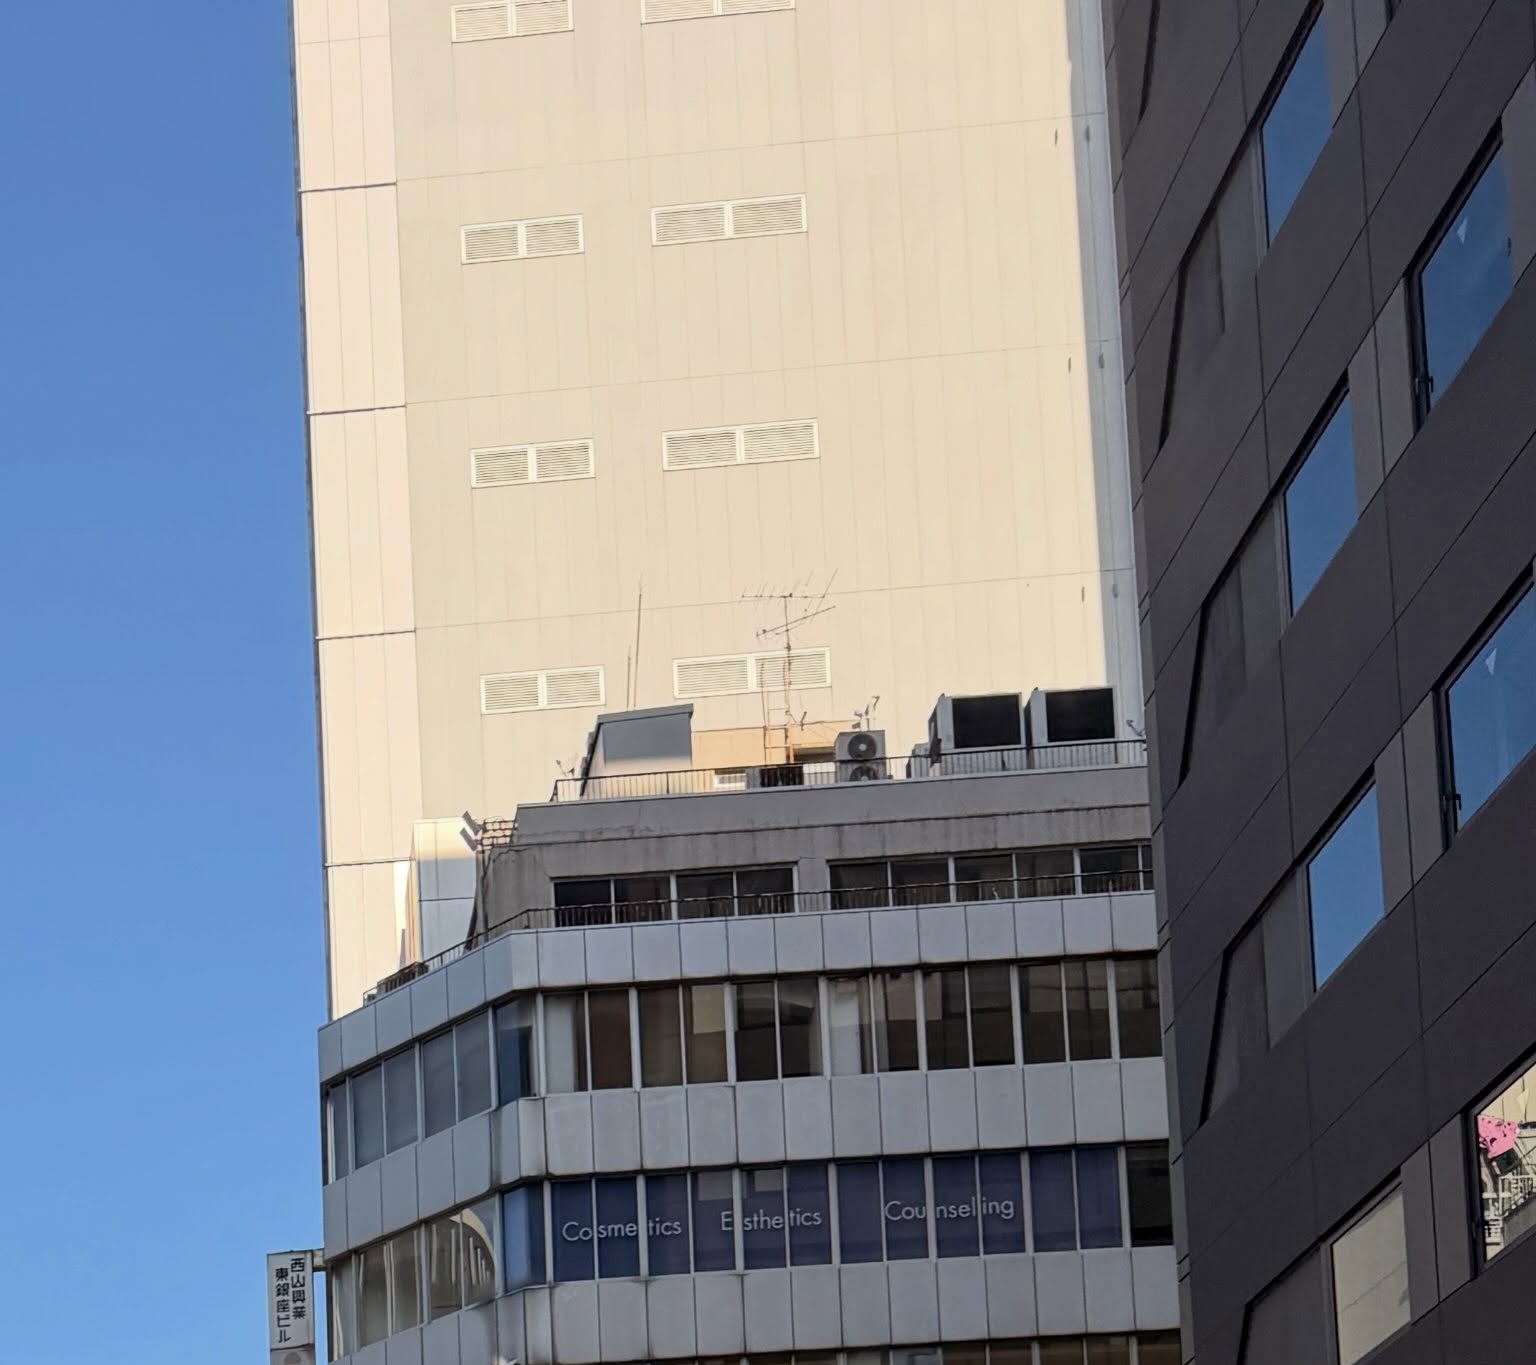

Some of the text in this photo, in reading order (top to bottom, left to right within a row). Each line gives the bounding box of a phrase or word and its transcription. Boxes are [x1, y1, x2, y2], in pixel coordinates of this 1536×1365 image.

[562, 1217, 682, 1241] Cosmetics
[721, 1208, 822, 1231] Esthetics
[275, 1267, 292, 1343] 東銀座ビル
